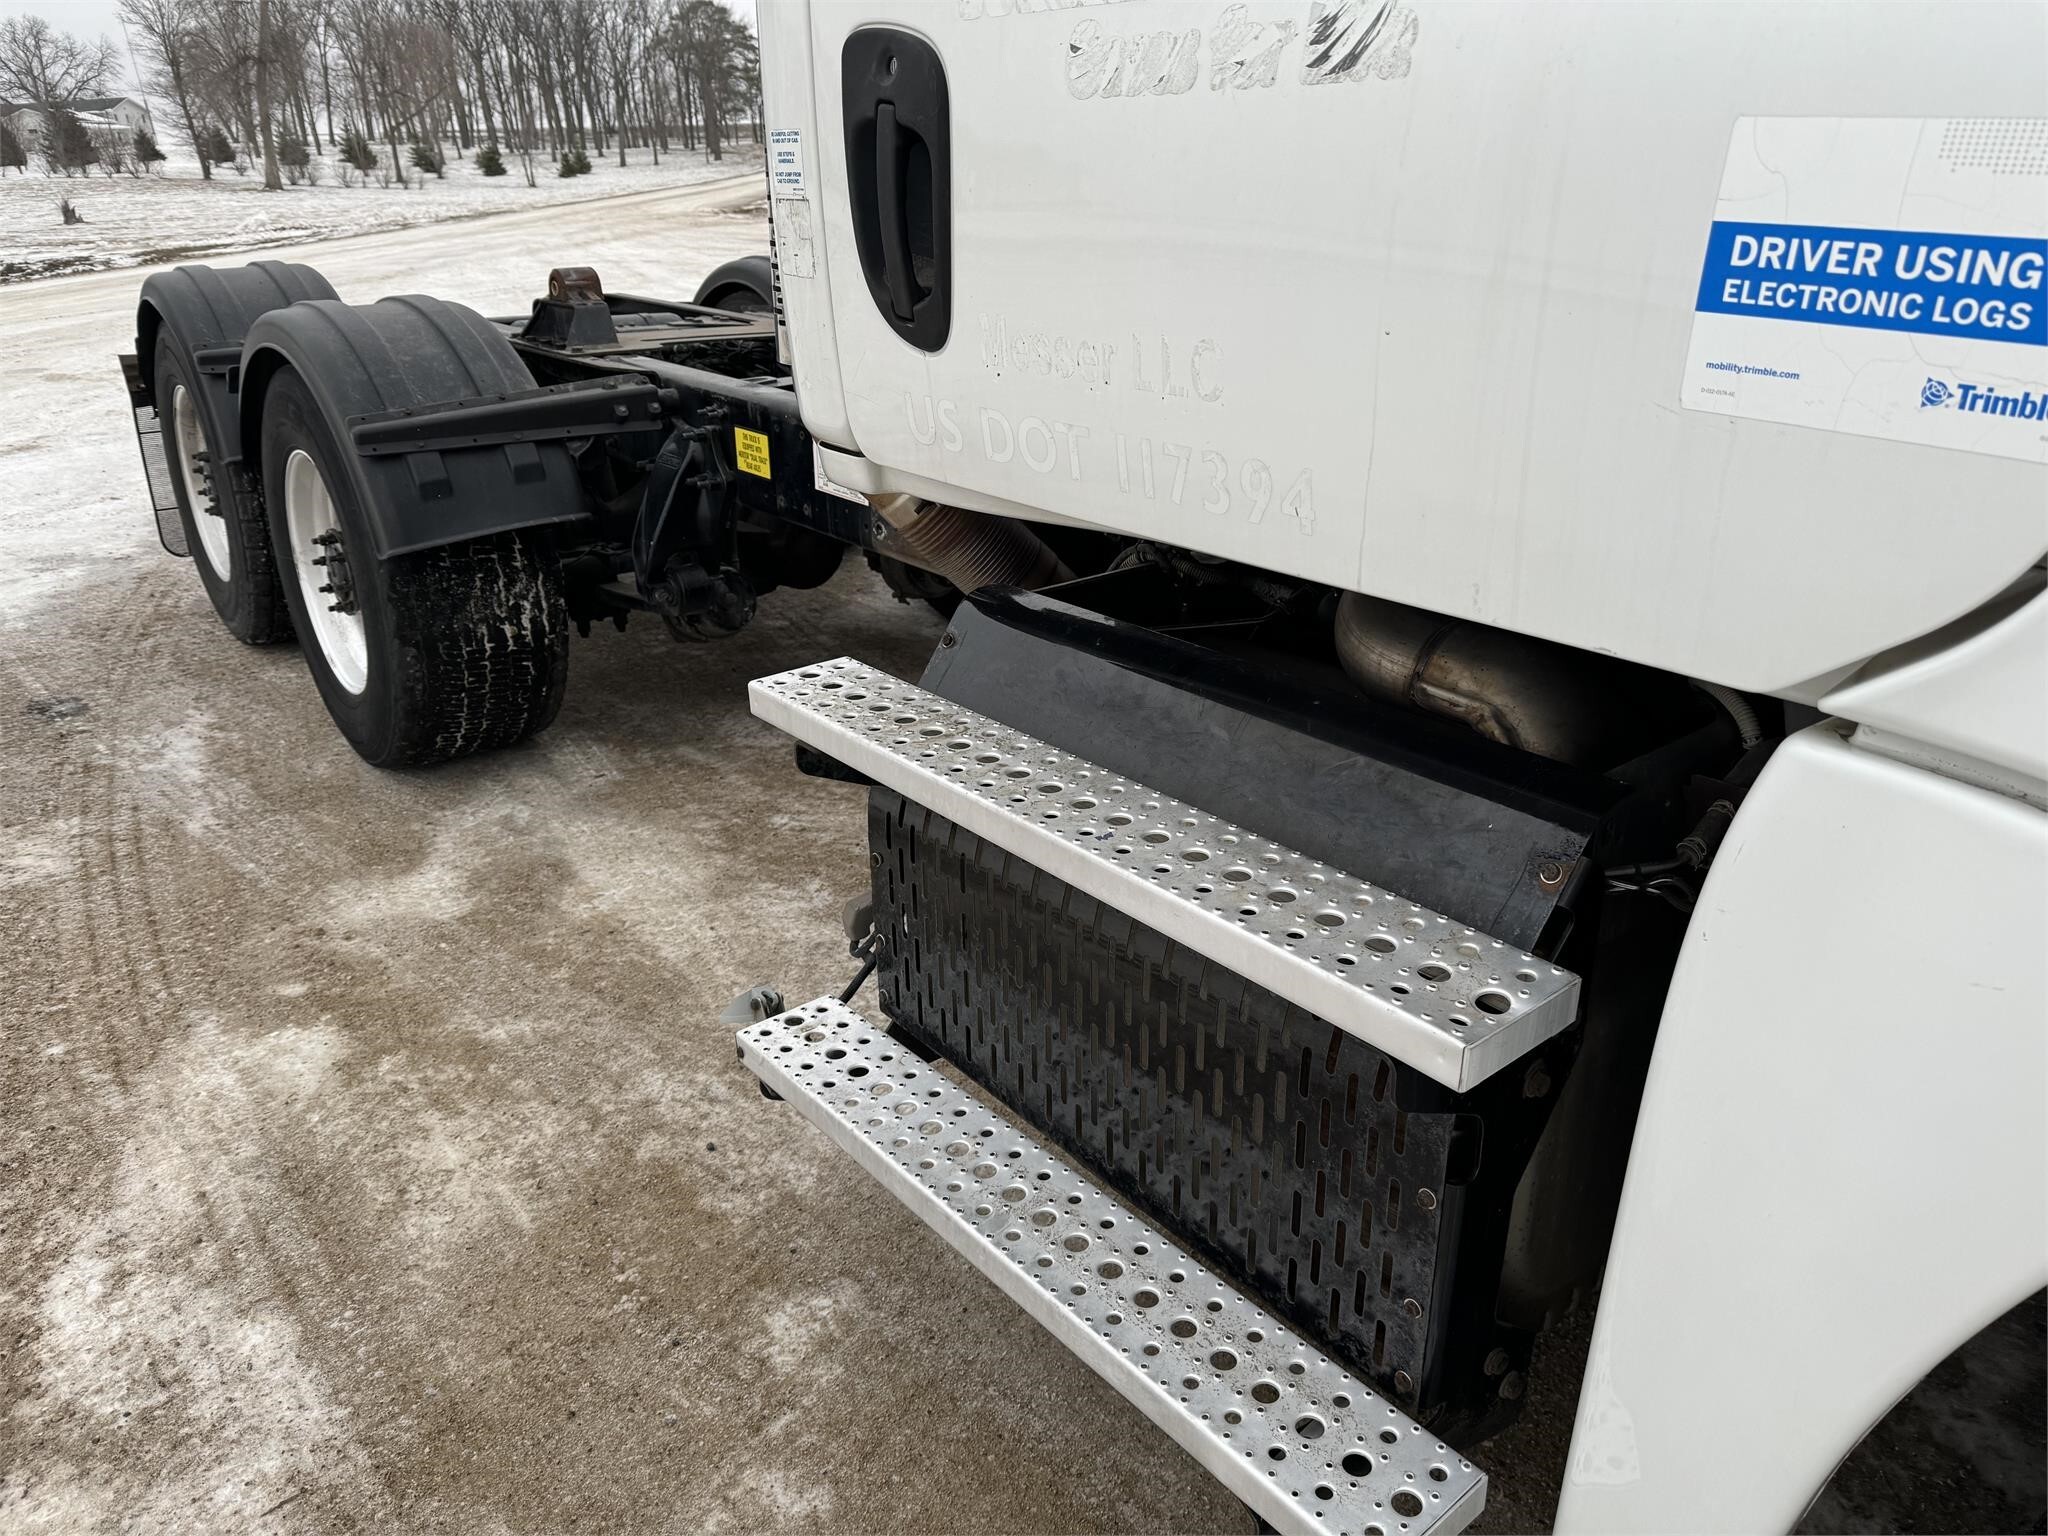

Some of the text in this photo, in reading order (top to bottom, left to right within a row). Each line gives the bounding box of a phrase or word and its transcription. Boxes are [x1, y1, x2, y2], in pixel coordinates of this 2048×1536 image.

[1728, 235, 2045, 290] DRIVER USING
[1722, 279, 2034, 331] ELECTRONIC LOGS
[1131, 330, 1225, 403] LLC
[1705, 361, 1800, 380] mobility.trimble.com
[1957, 383, 2048, 422] Trimbl
[903, 391, 1317, 537] US DOT 117394
